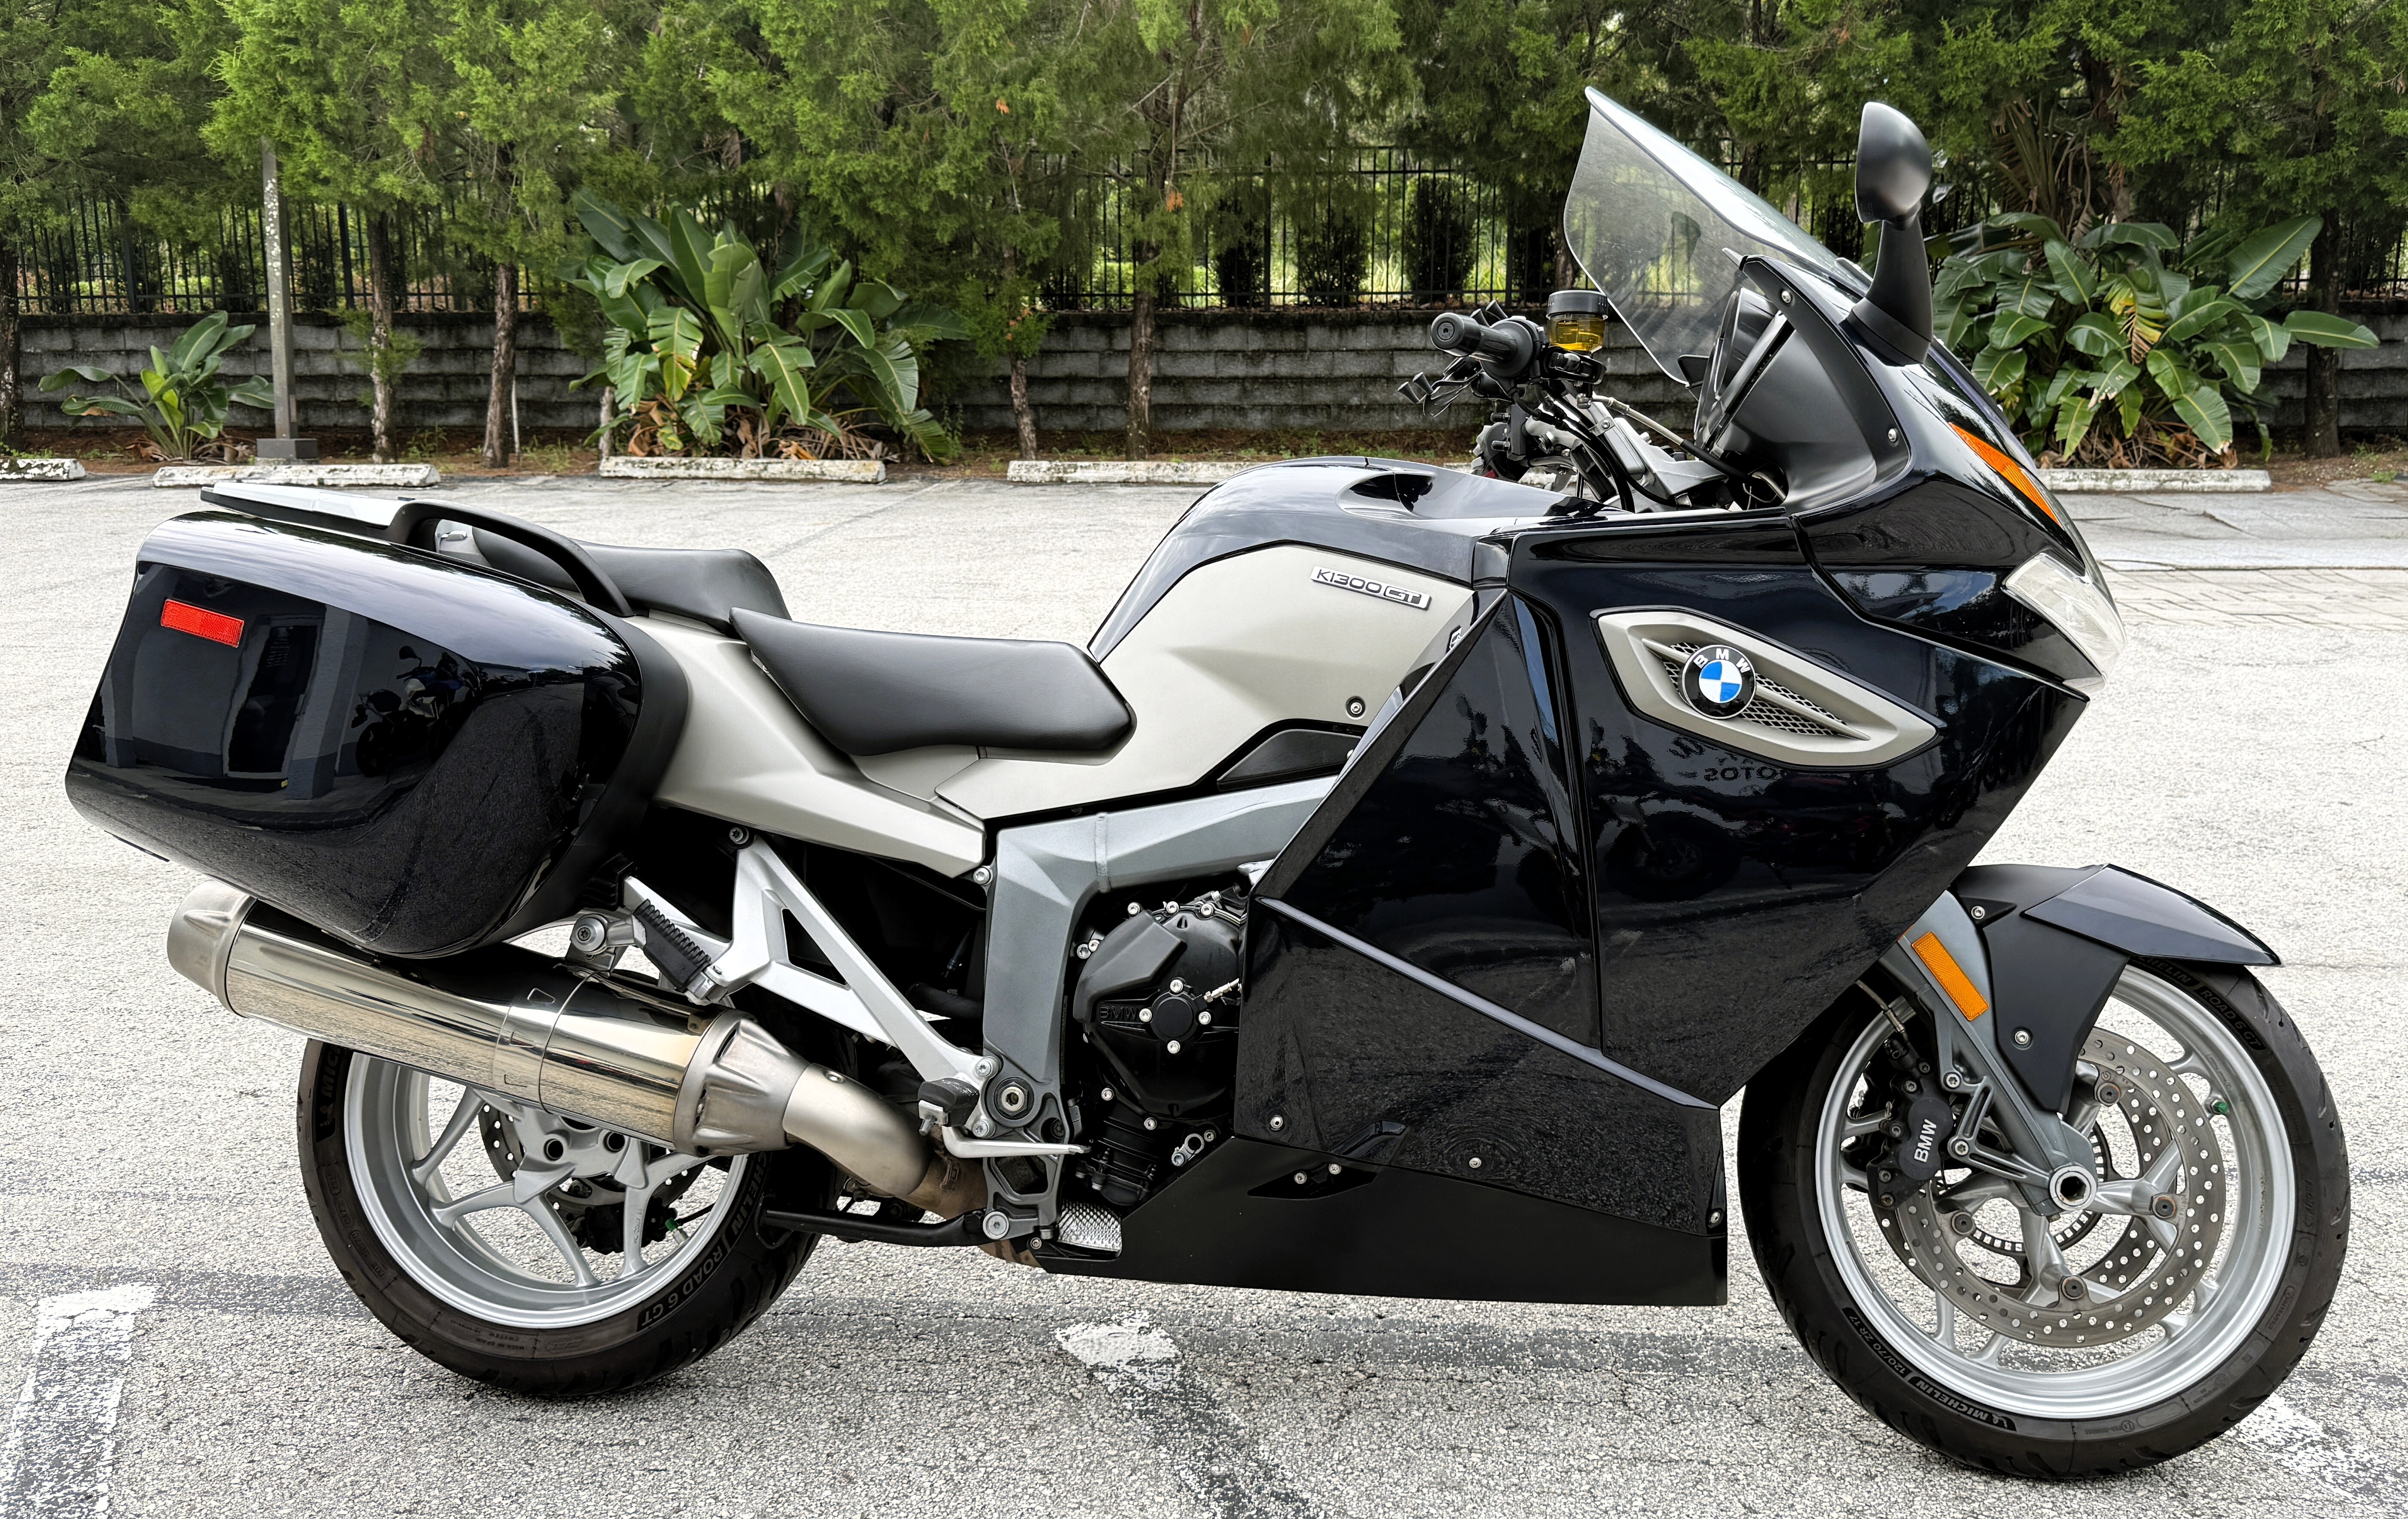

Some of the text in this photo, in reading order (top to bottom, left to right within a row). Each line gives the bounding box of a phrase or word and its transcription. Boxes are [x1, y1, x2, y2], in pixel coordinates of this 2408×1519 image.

[1693, 648, 1751, 673] BMW
[1099, 1005, 1139, 1021] BMW
[2200, 989, 2261, 1045] ROAD 6 GT
[1914, 1119, 1937, 1163] BMW
[731, 1151, 766, 1235] CHELIN
[641, 1245, 723, 1326] ROAD 6 GT
[1849, 1315, 1906, 1374] 120/70 ZR 17
[1915, 1380, 1989, 1421] MICHELIN
